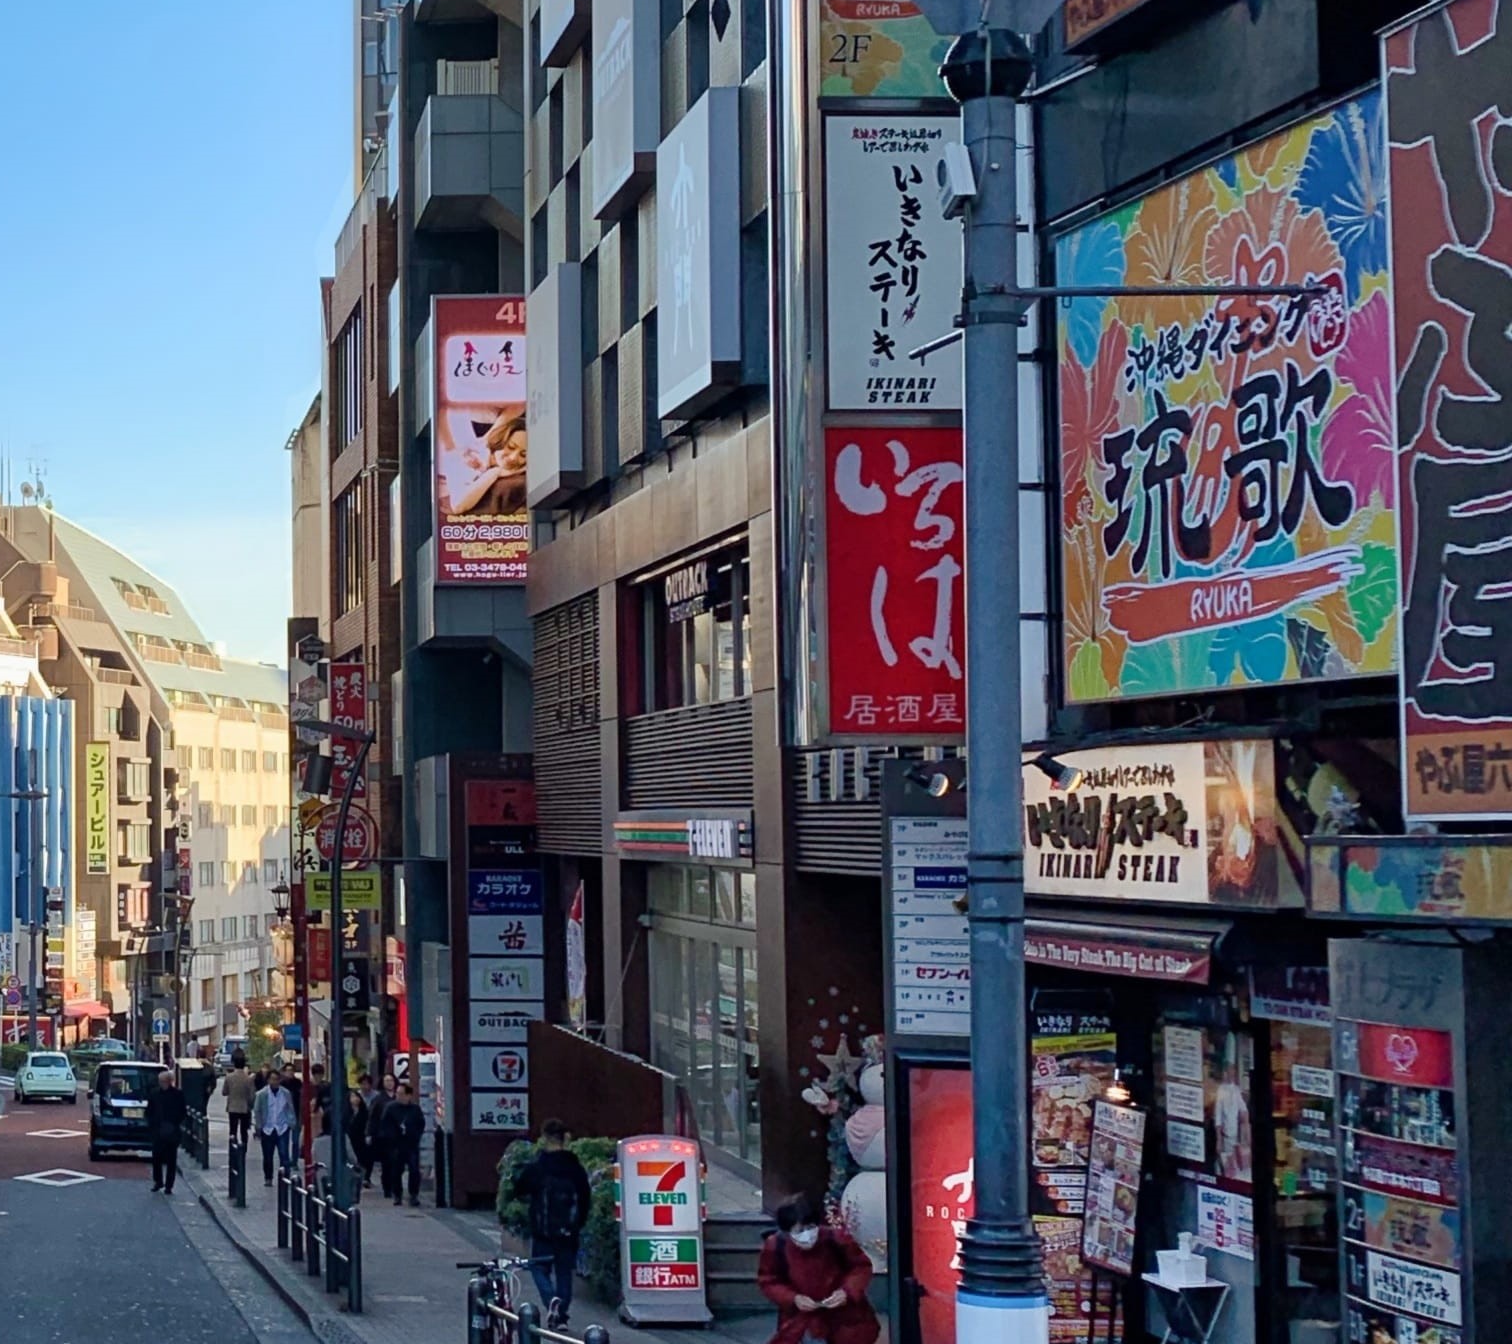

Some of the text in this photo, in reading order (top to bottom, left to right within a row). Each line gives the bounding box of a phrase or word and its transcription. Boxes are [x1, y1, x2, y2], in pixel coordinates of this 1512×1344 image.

[856, 3, 901, 17] RYUKA
[828, 34, 872, 64] 2F
[892, 164, 928, 299] いきなり
[868, 239, 898, 361] ステーキ
[866, 377, 937, 390] IKINARI
[868, 391, 932, 404] STEAK
[1101, 363, 1355, 580] 琉歌
[444, 563, 463, 572] TEL
[1190, 579, 1254, 623] RYUKA
[844, 693, 963, 725] 居酒屋
[89, 752, 106, 850] シュアービル
[1117, 854, 1181, 884] STEAK
[477, 883, 532, 896] カラオケ
[649, 1240, 679, 1263] 酒
